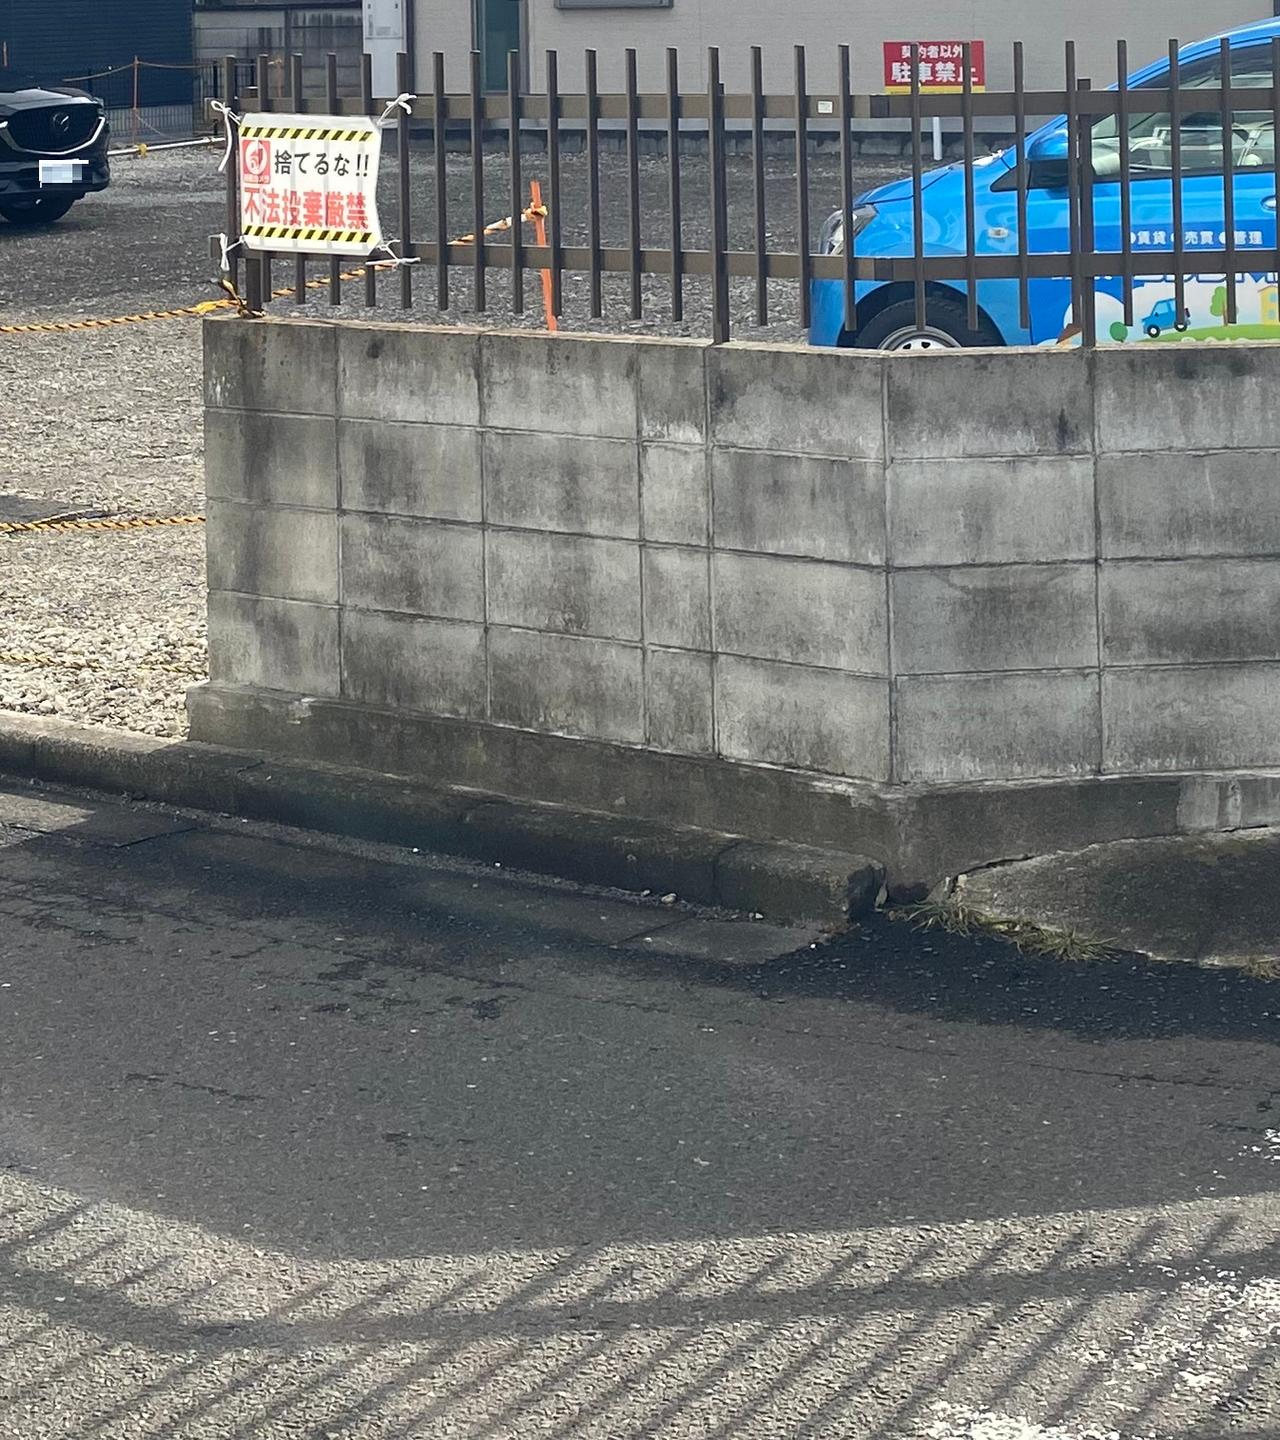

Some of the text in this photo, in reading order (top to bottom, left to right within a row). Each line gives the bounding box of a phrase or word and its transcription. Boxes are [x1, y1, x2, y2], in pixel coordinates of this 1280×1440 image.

[891, 61, 979, 83] 駐車禁止
[243, 186, 370, 230] 不法投棄厳禁
